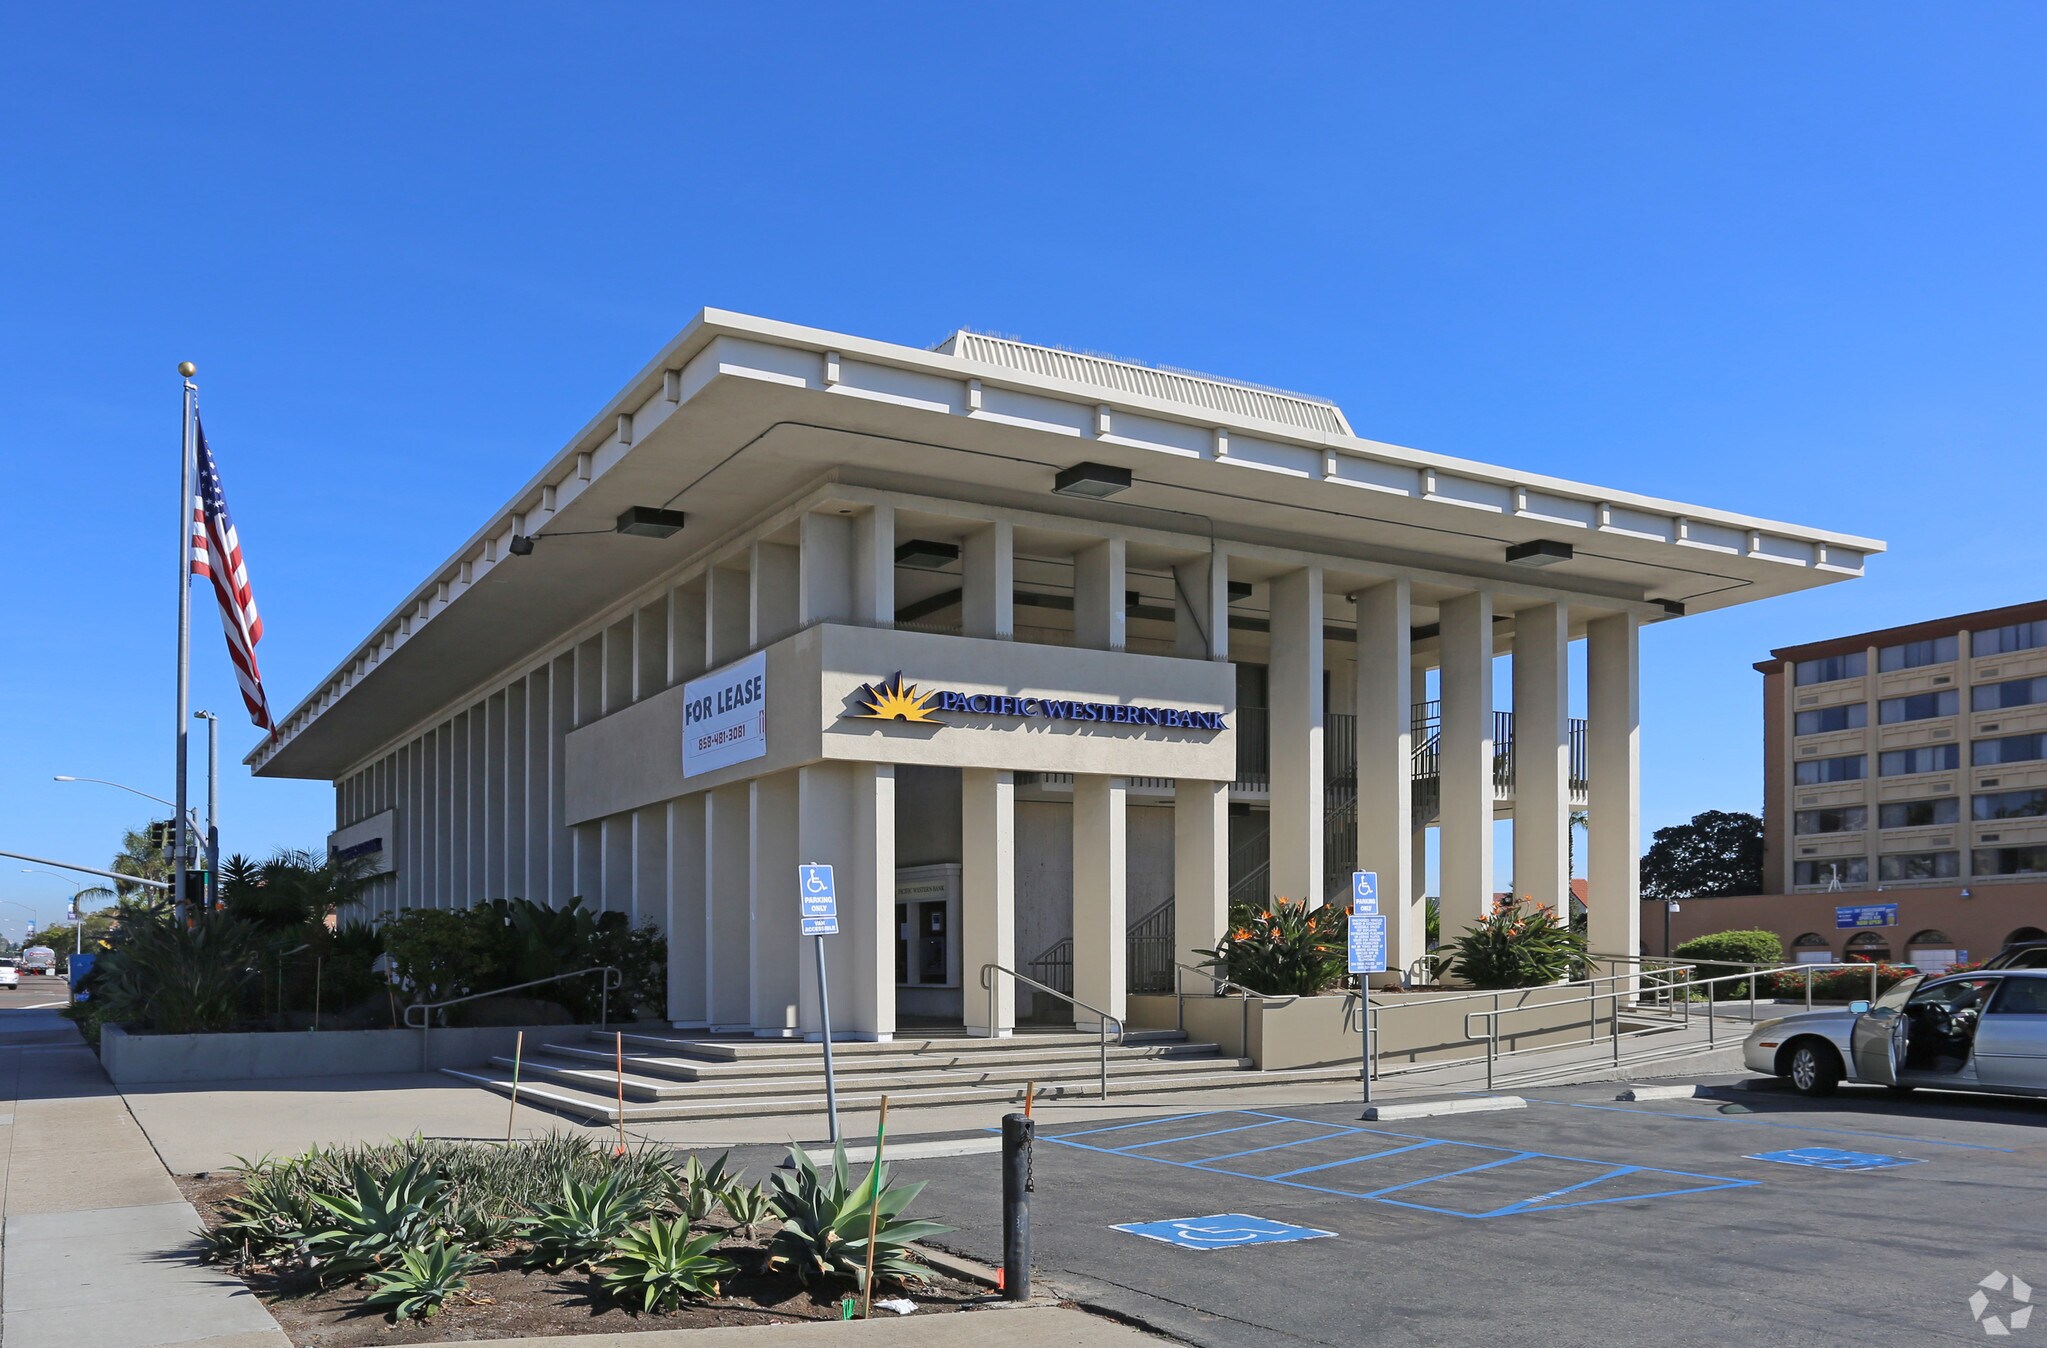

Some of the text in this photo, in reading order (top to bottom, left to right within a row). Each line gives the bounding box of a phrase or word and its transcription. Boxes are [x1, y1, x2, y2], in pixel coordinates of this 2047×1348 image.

[685, 674, 762, 726] FOR LEASE
[940, 690, 1230, 730] PACIFIC WESTERN BANK
[804, 896, 833, 904] PARKING
